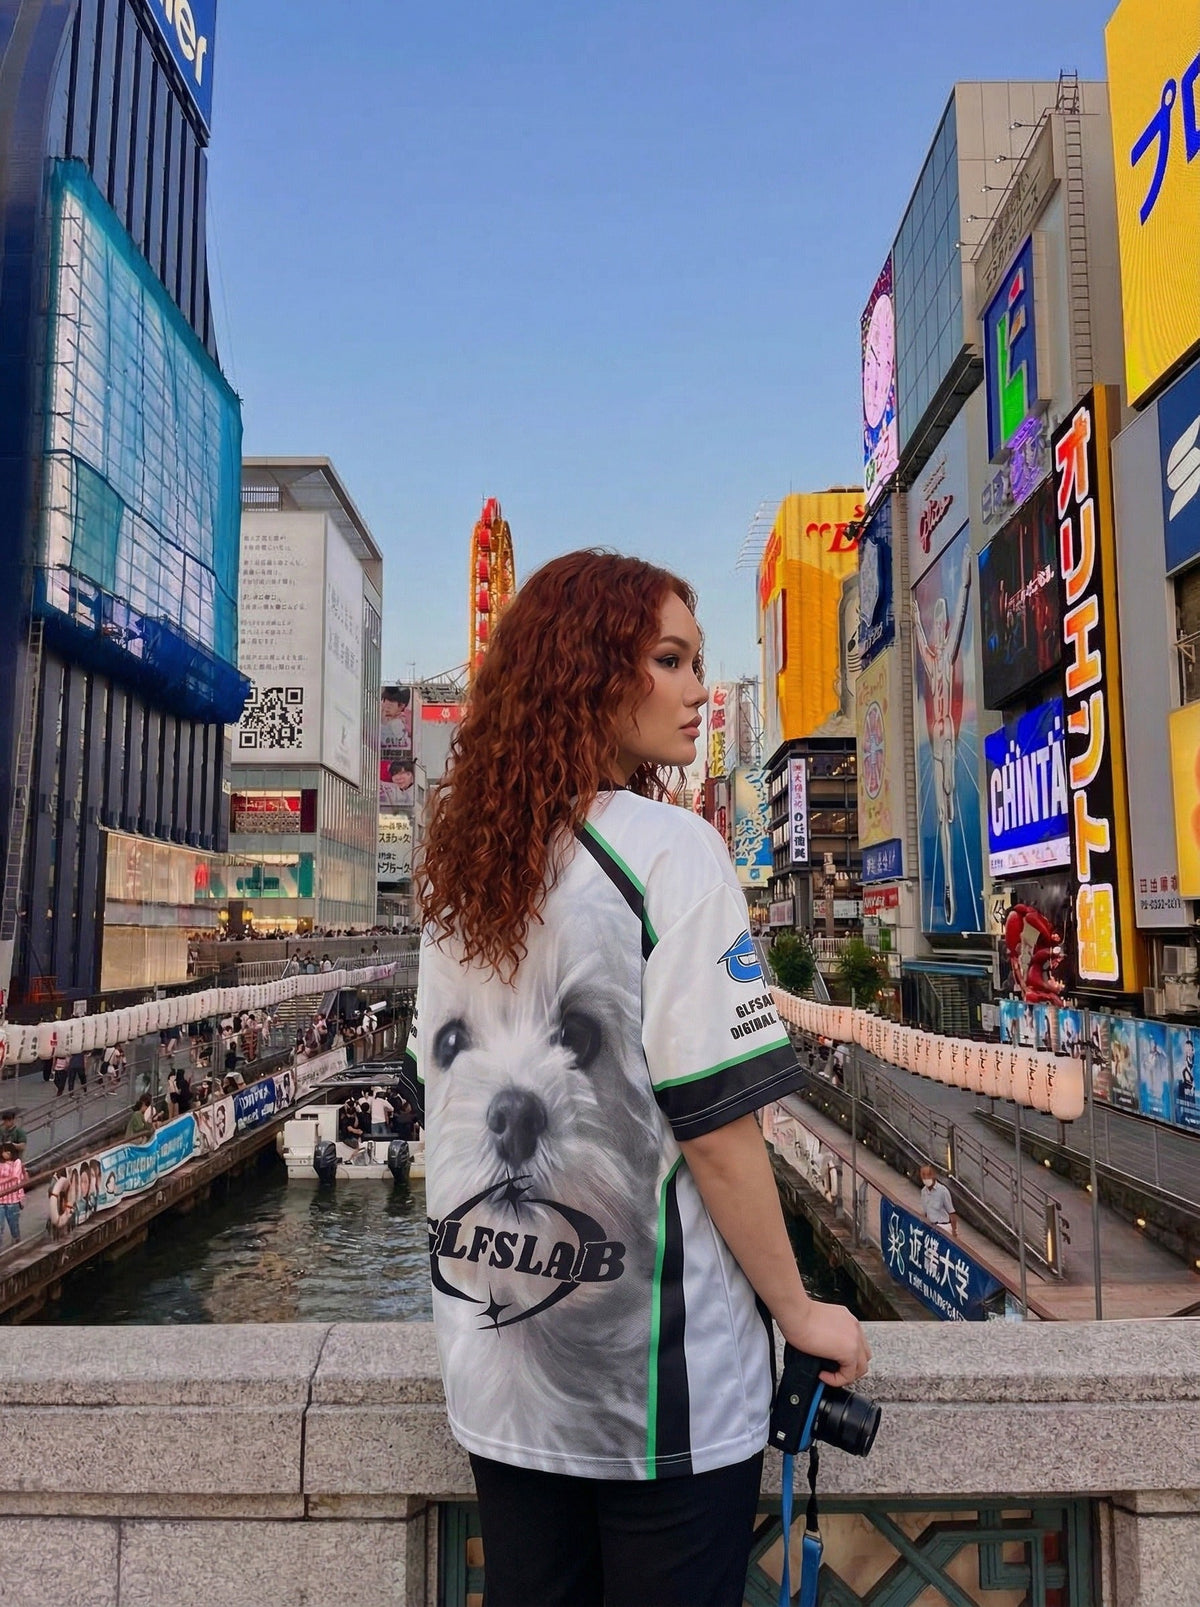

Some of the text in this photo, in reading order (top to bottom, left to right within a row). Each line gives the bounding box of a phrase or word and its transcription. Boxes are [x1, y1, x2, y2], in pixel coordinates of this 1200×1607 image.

[1056, 406, 1119, 981] オリエント
